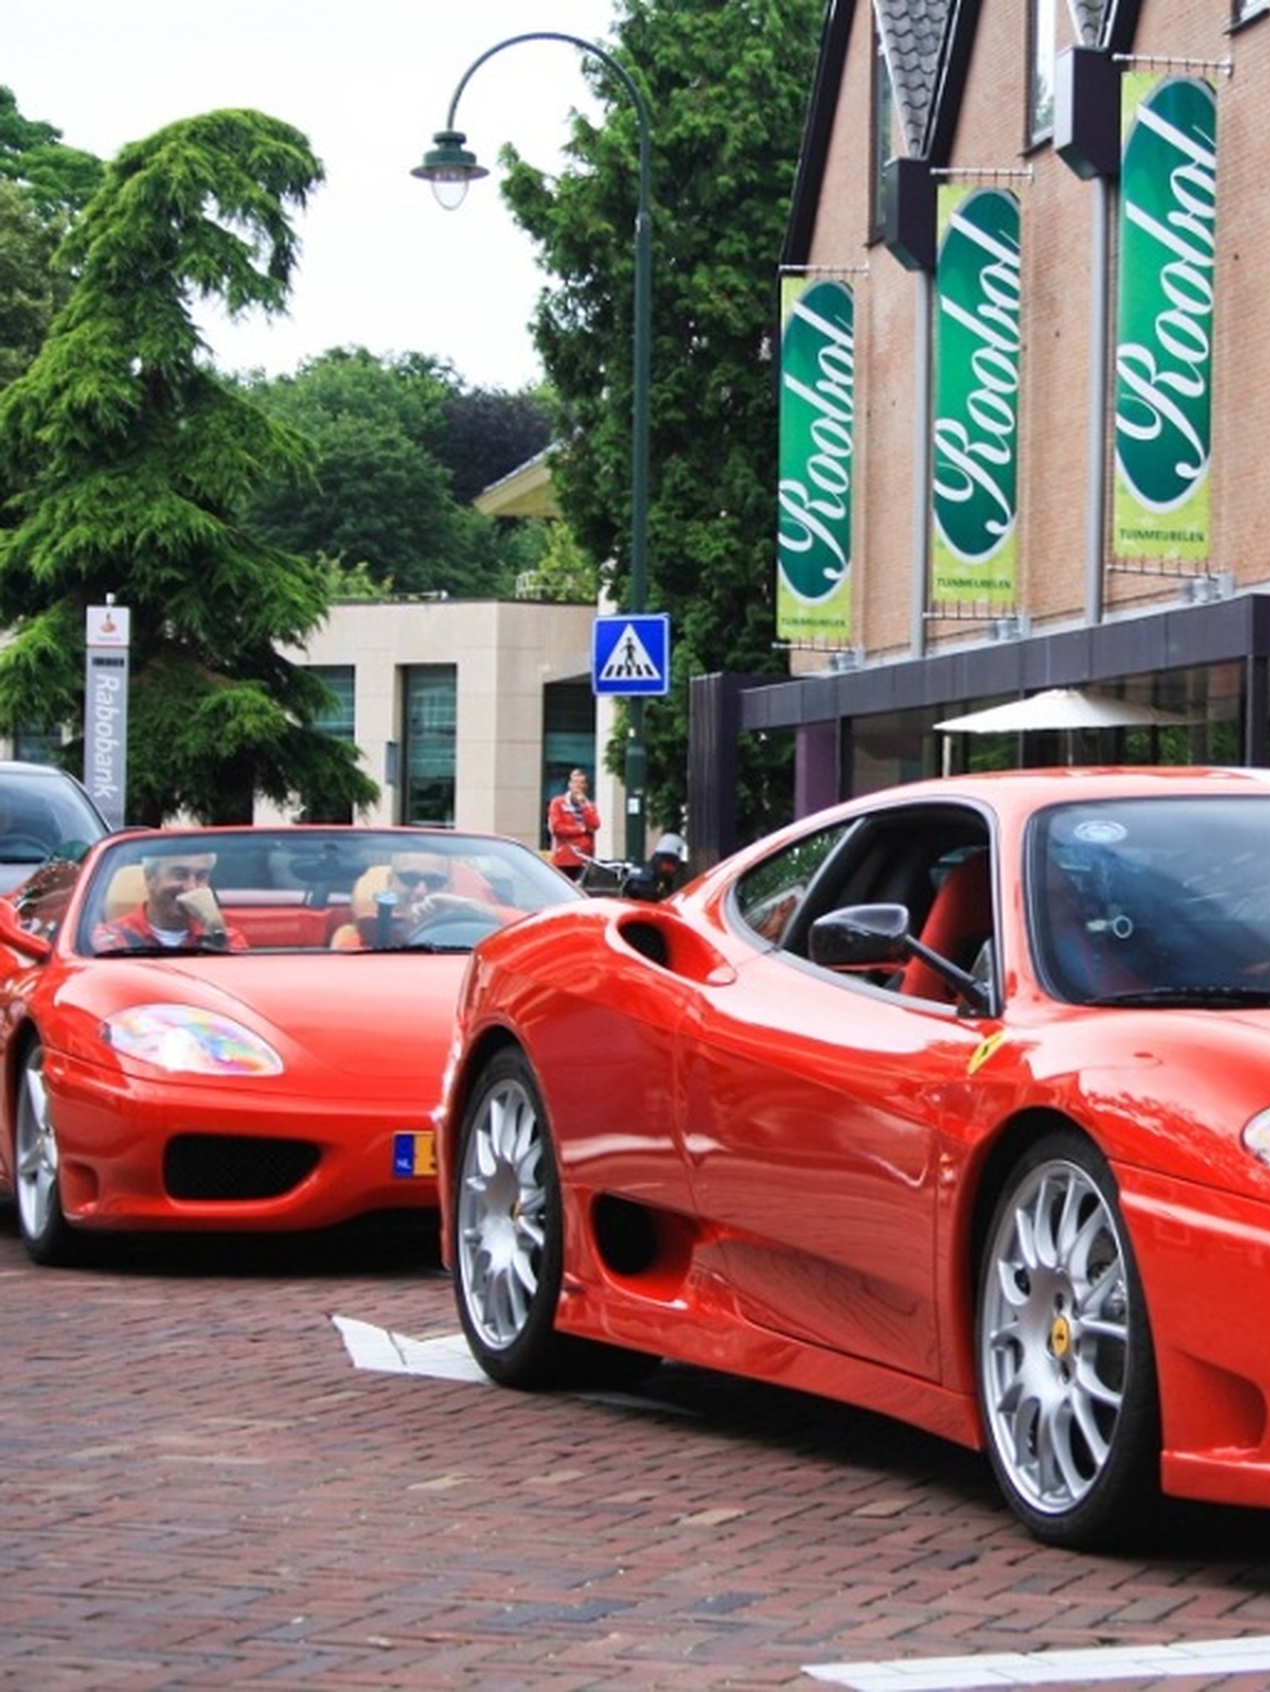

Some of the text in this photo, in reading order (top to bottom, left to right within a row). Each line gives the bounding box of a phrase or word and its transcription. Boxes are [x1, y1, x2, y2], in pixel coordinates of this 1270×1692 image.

[933, 211, 1020, 536] Roobol
[1115, 103, 1217, 480] Roobol
[778, 300, 854, 580] Roobol
[1119, 528, 1205, 543] TUINMEUBELEN
[937, 577, 1011, 589] TUINMEUBELEN
[94, 673, 120, 799] Rabobank
